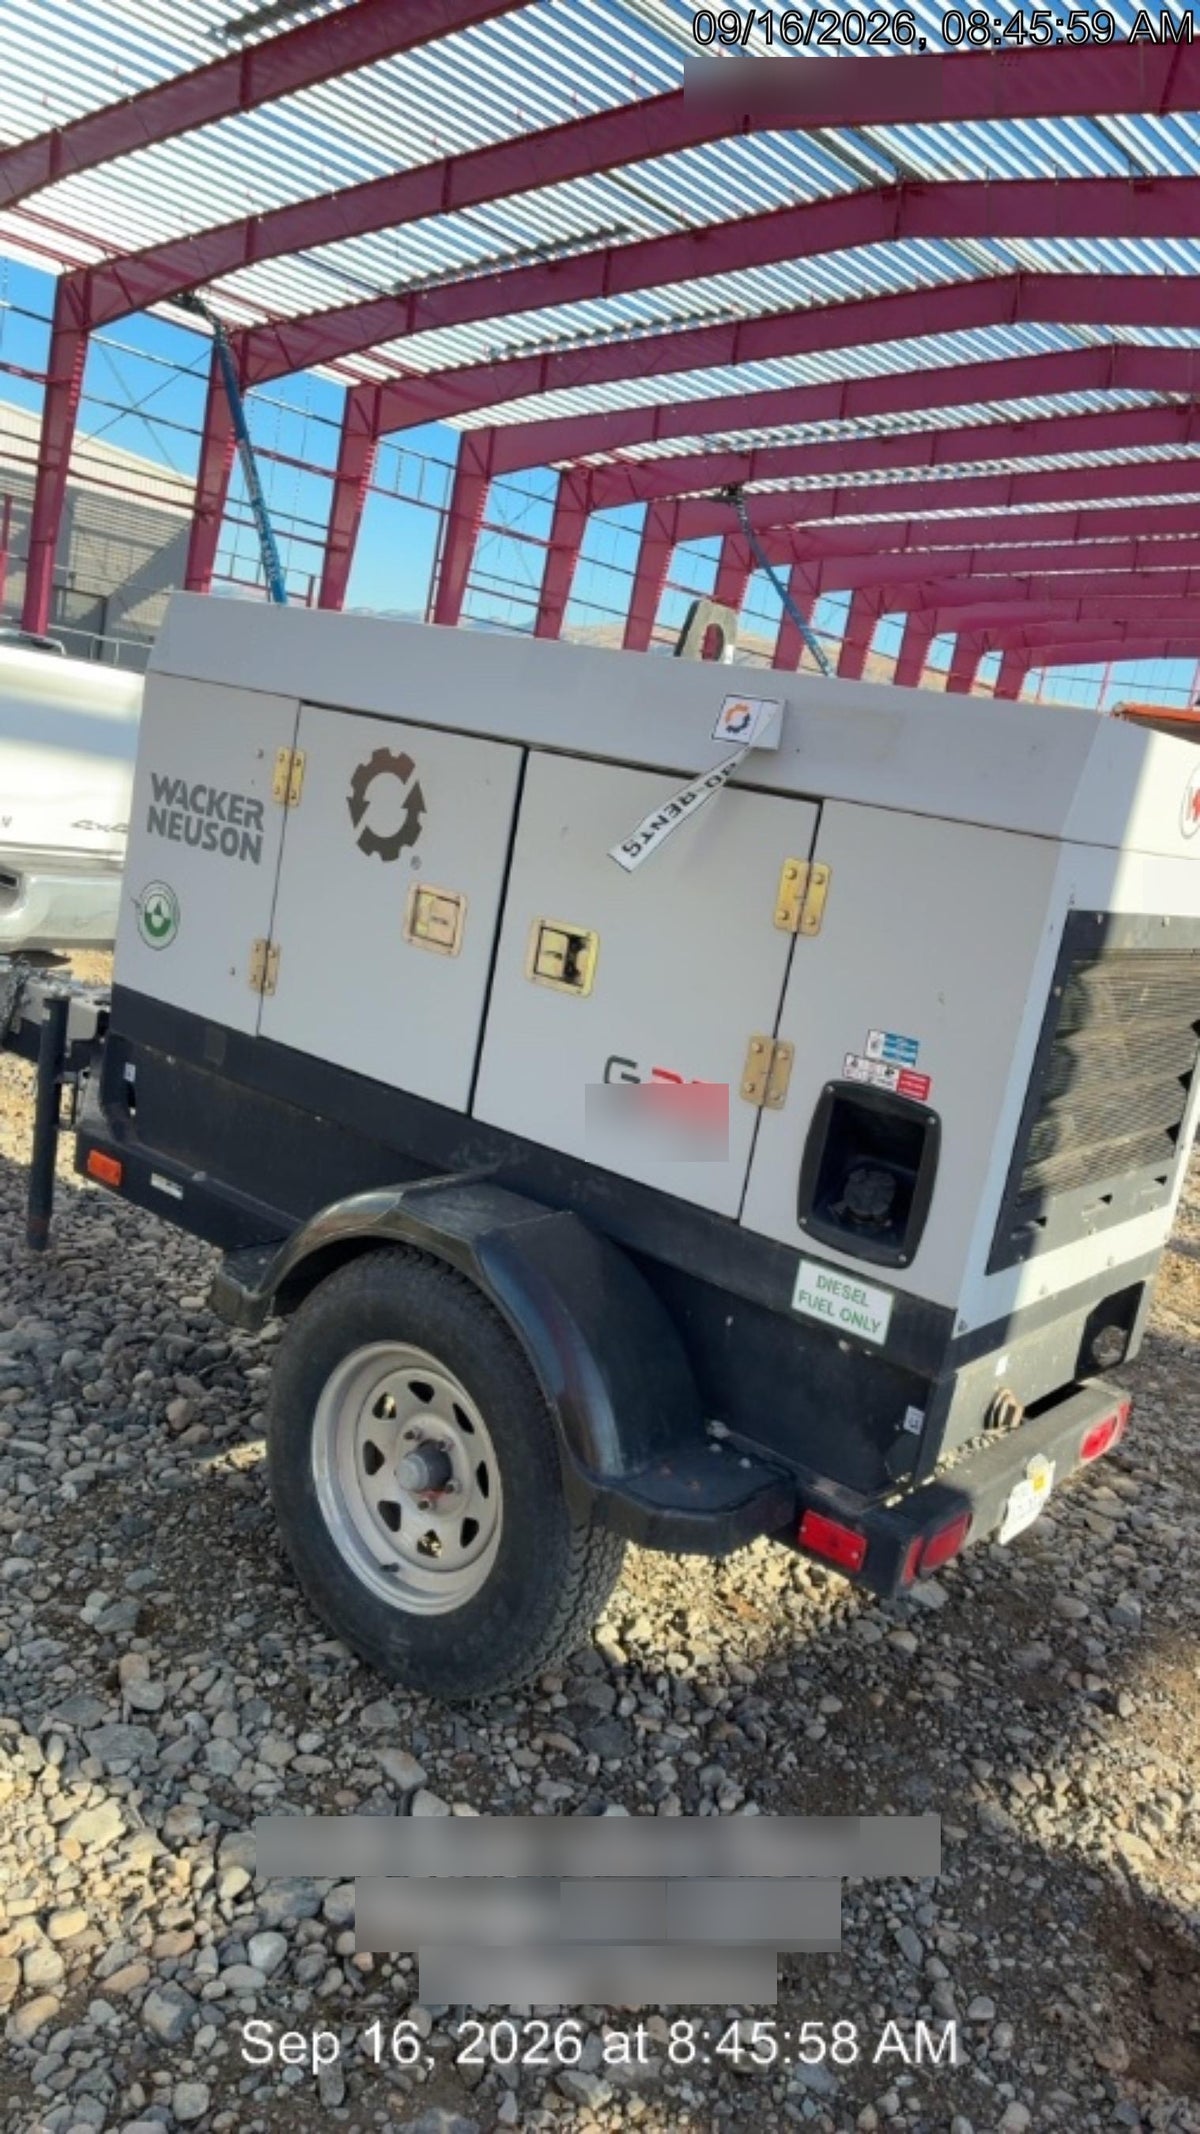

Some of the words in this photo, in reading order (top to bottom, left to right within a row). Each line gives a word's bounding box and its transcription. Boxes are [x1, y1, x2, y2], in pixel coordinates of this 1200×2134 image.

[151, 772, 265, 832] WACKER
[147, 805, 264, 865] NEUSON
[799, 1289, 835, 1317] FUEL
[839, 1307, 881, 1334] ONLY
[816, 1275, 869, 1308] DIESEL
